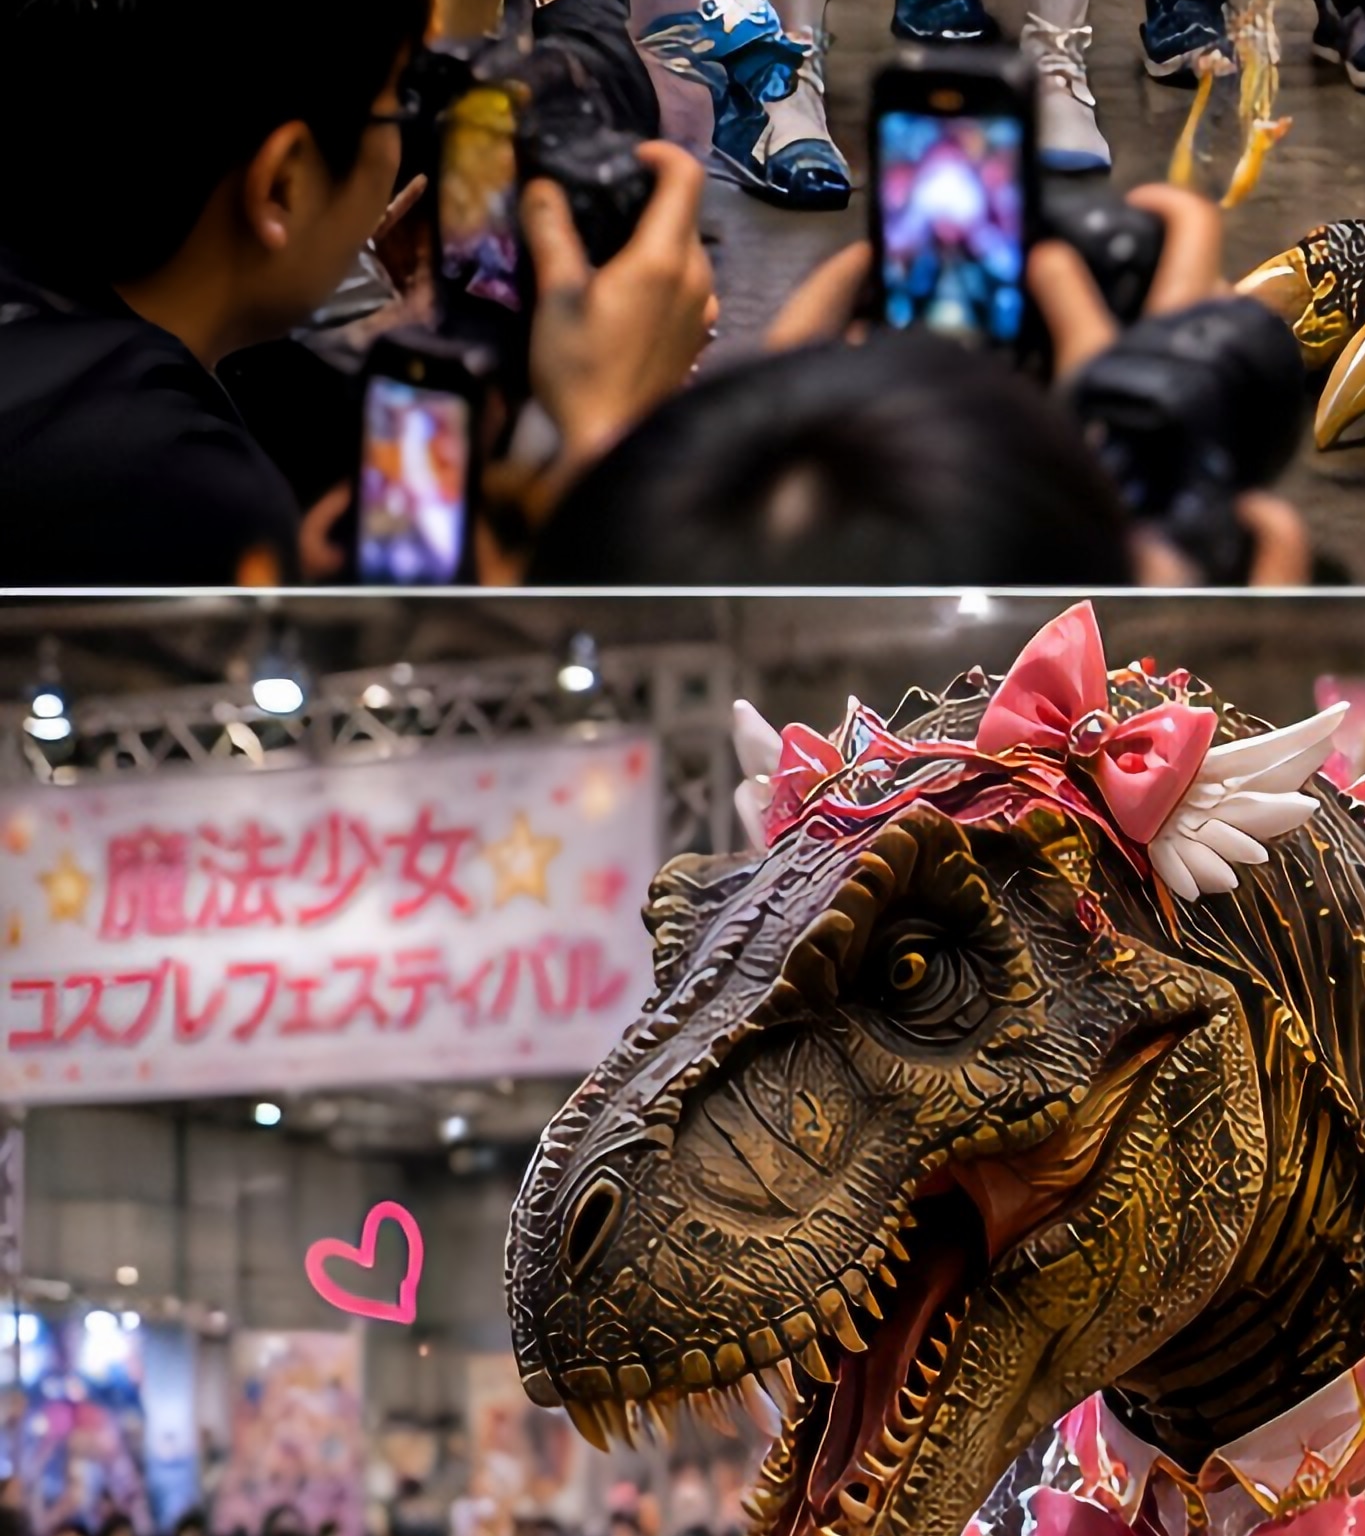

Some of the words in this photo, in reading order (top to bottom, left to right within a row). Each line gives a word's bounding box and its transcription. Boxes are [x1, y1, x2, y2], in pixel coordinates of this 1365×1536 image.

[101, 803, 477, 941] 魔法少女
[7, 935, 631, 1050] コスプレフェスティバル
